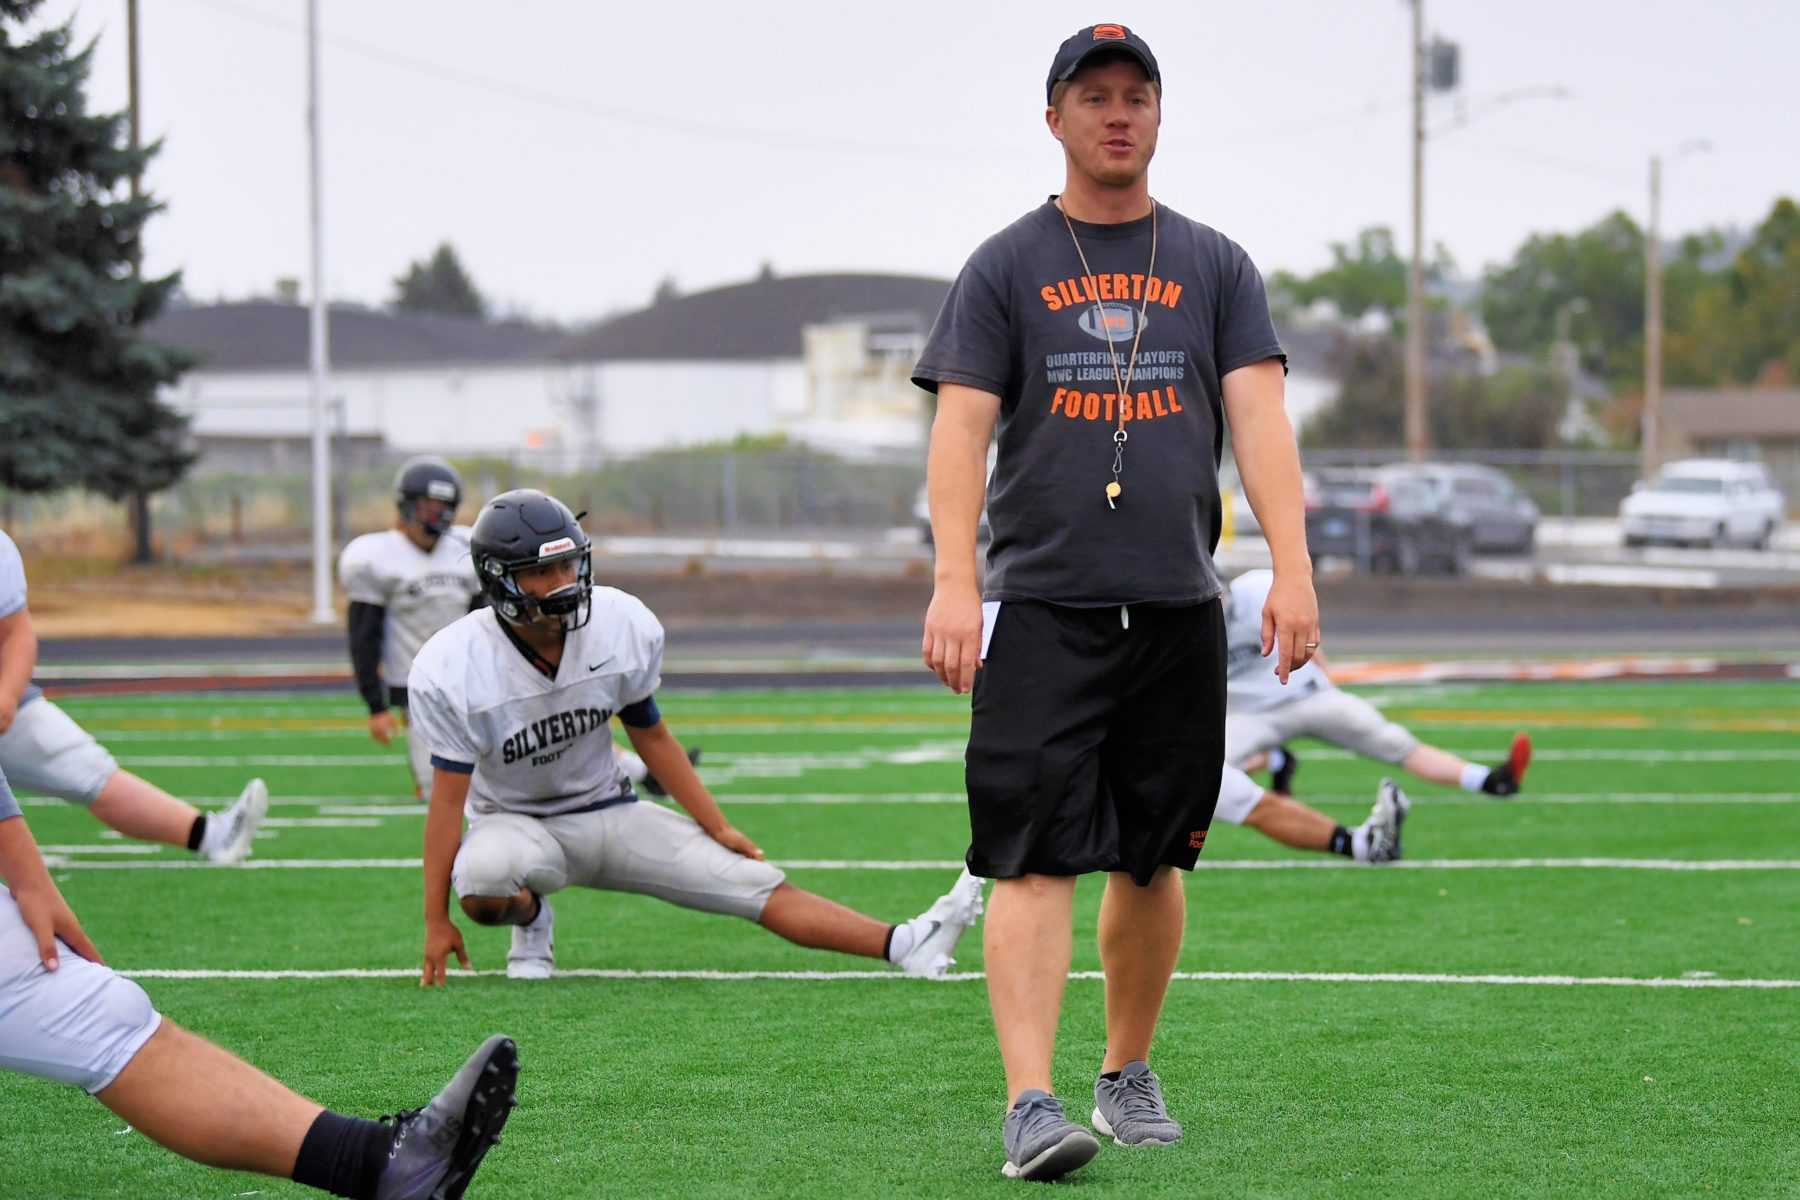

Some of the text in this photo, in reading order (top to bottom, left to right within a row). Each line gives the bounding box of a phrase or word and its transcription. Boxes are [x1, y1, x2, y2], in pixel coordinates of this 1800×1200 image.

[1040, 273, 1183, 311] SILVERTON
[1132, 350, 1185, 364] LAYOFFS
[1047, 368, 1073, 383] MWC
[1077, 367, 1117, 381] LEAGUE
[1050, 385, 1183, 421] FOOTBALL
